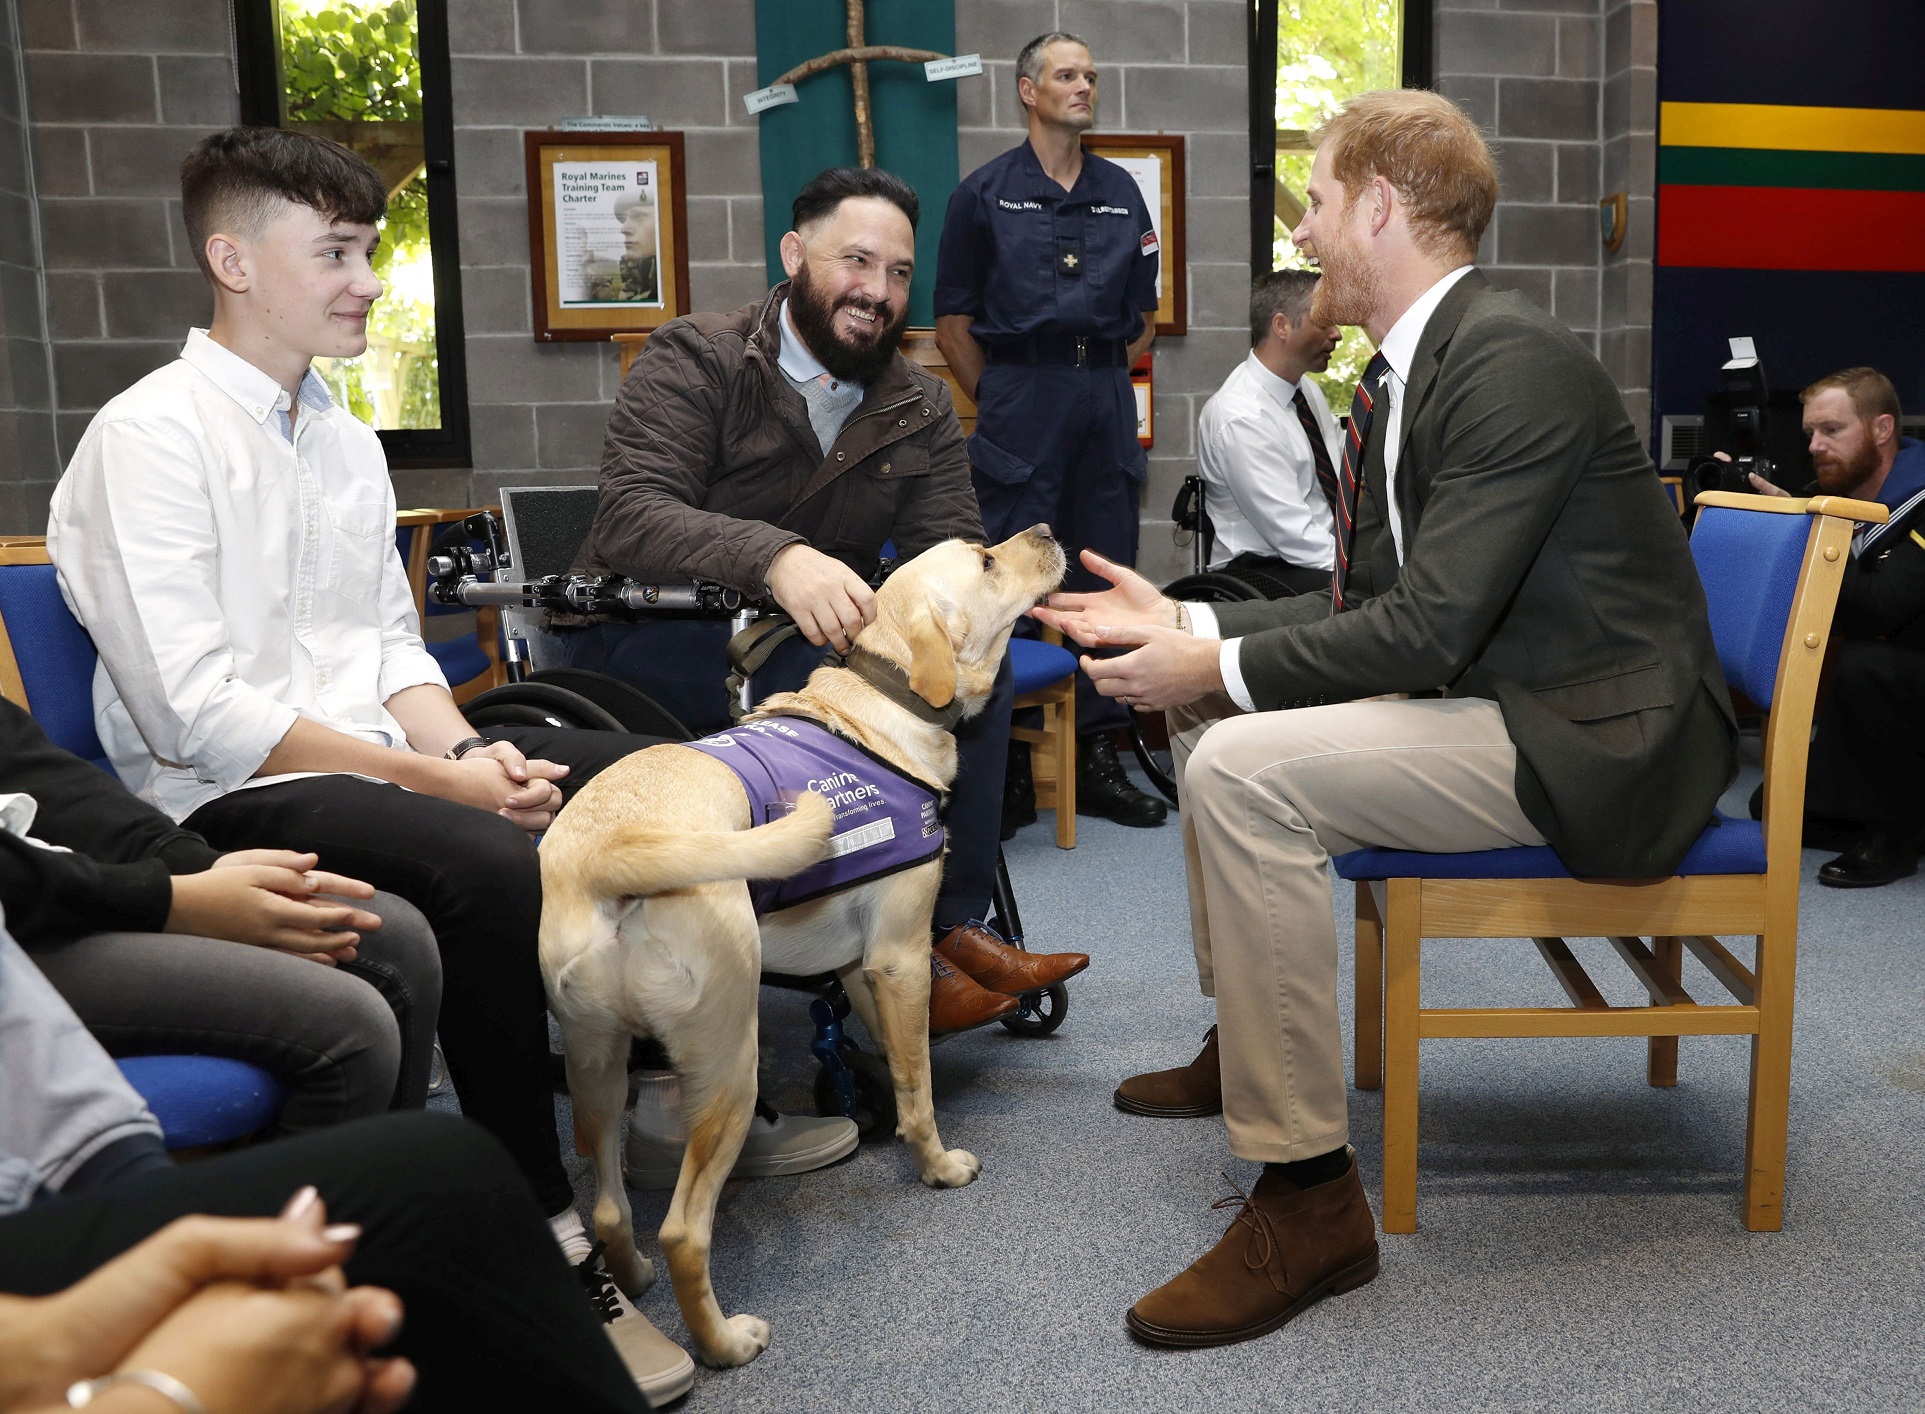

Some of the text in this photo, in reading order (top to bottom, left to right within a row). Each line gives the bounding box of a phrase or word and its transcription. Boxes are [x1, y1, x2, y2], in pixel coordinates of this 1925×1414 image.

[929, 61, 977, 74] SELF-DISCIPLINE
[757, 91, 786, 104] INTEGRITY
[561, 172, 626, 183] Royal Marines
[562, 183, 625, 194] Training Team
[562, 194, 597, 203] Charter
[999, 199, 1042, 210] ROYAL NAVY
[752, 720, 800, 738] LEASE
[826, 784, 880, 810] artners
